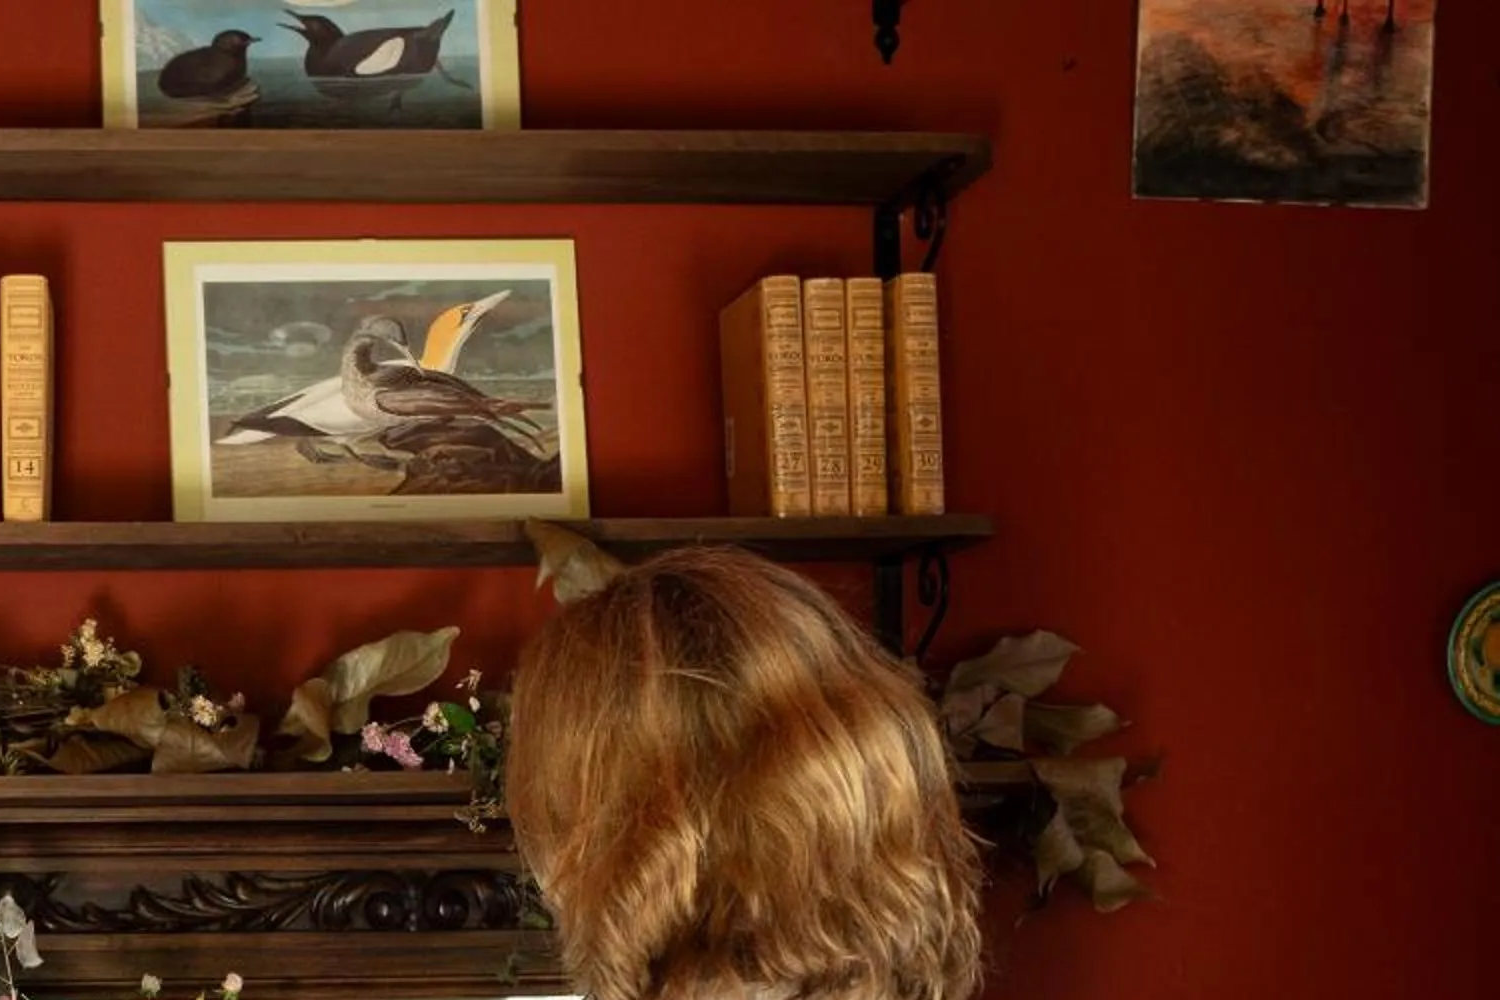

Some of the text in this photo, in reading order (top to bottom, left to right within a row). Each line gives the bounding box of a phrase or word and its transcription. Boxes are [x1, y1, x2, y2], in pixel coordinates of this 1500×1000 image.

[16, 460, 35, 475] 14
[781, 454, 801, 470] 27
[821, 459, 842, 472] 28
